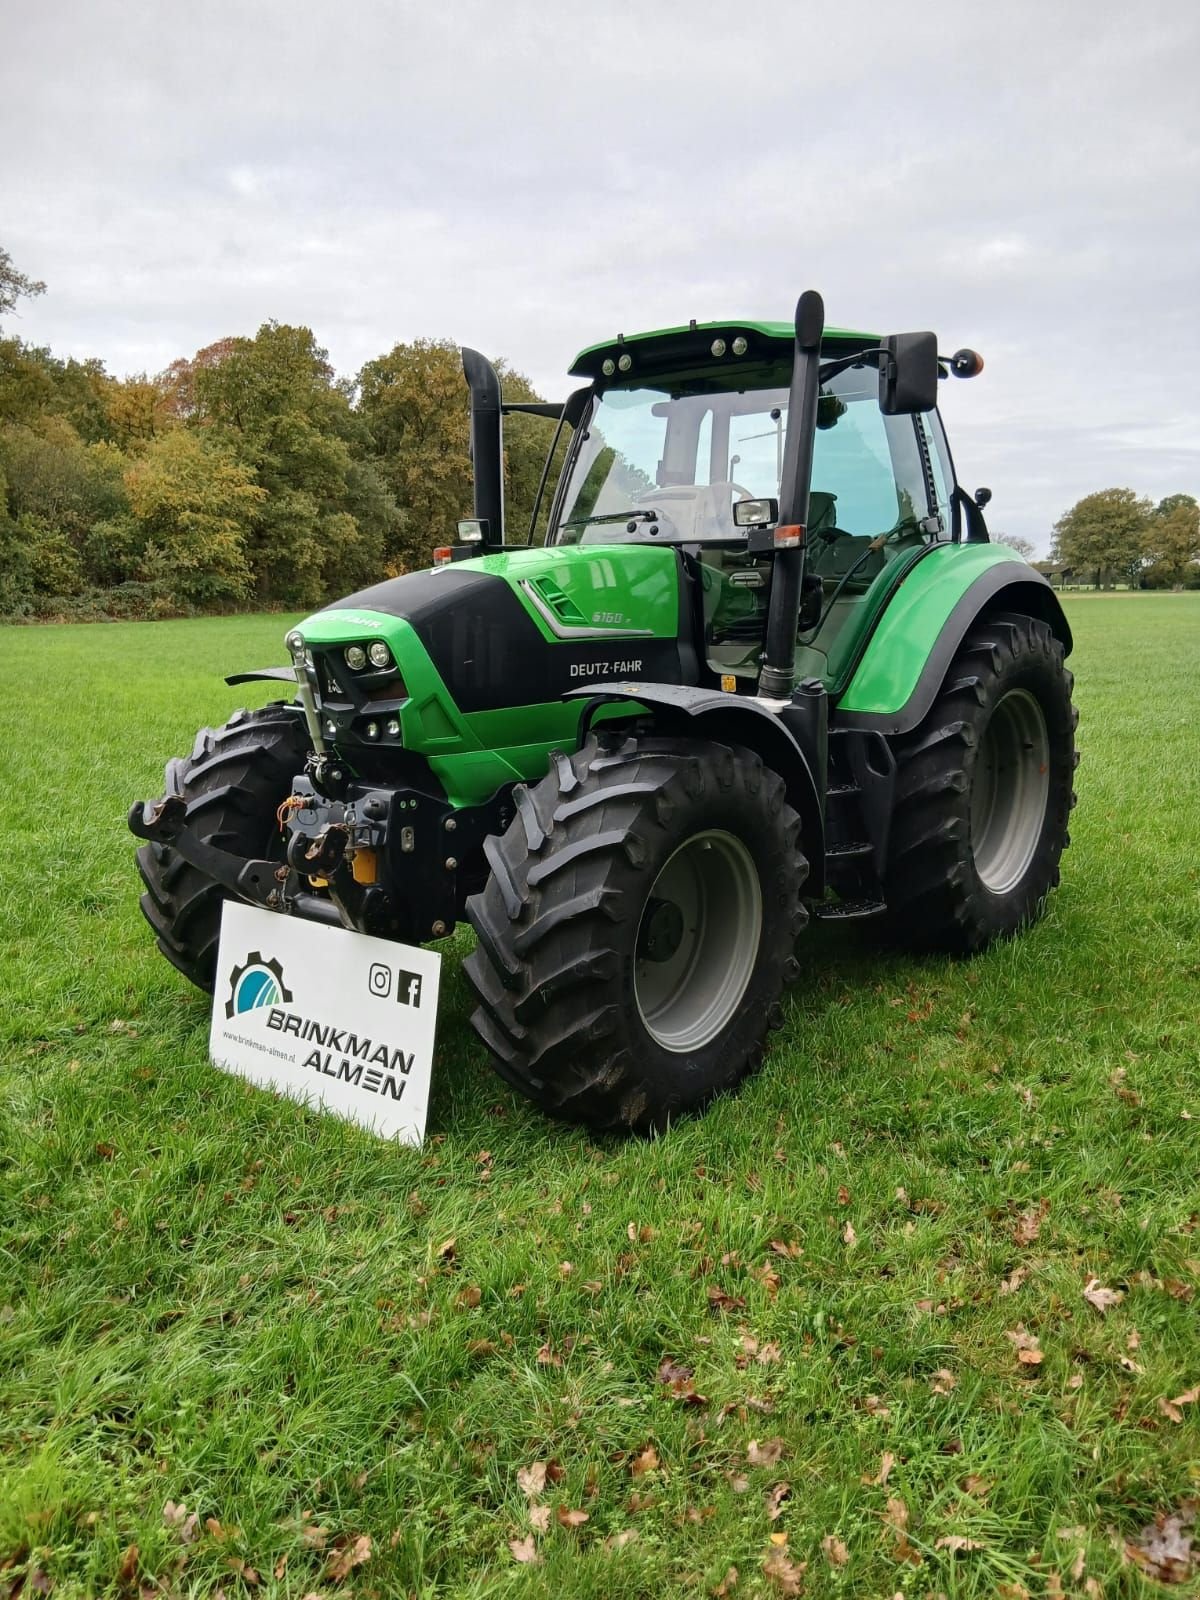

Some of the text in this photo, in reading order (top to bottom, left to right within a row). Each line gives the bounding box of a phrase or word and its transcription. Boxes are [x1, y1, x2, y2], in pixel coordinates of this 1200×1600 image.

[223, 1031, 296, 1063] www.brinkman-almen.nl
[266, 1008, 415, 1075] BRINKMAN
[302, 1049, 406, 1101] ALMEN
